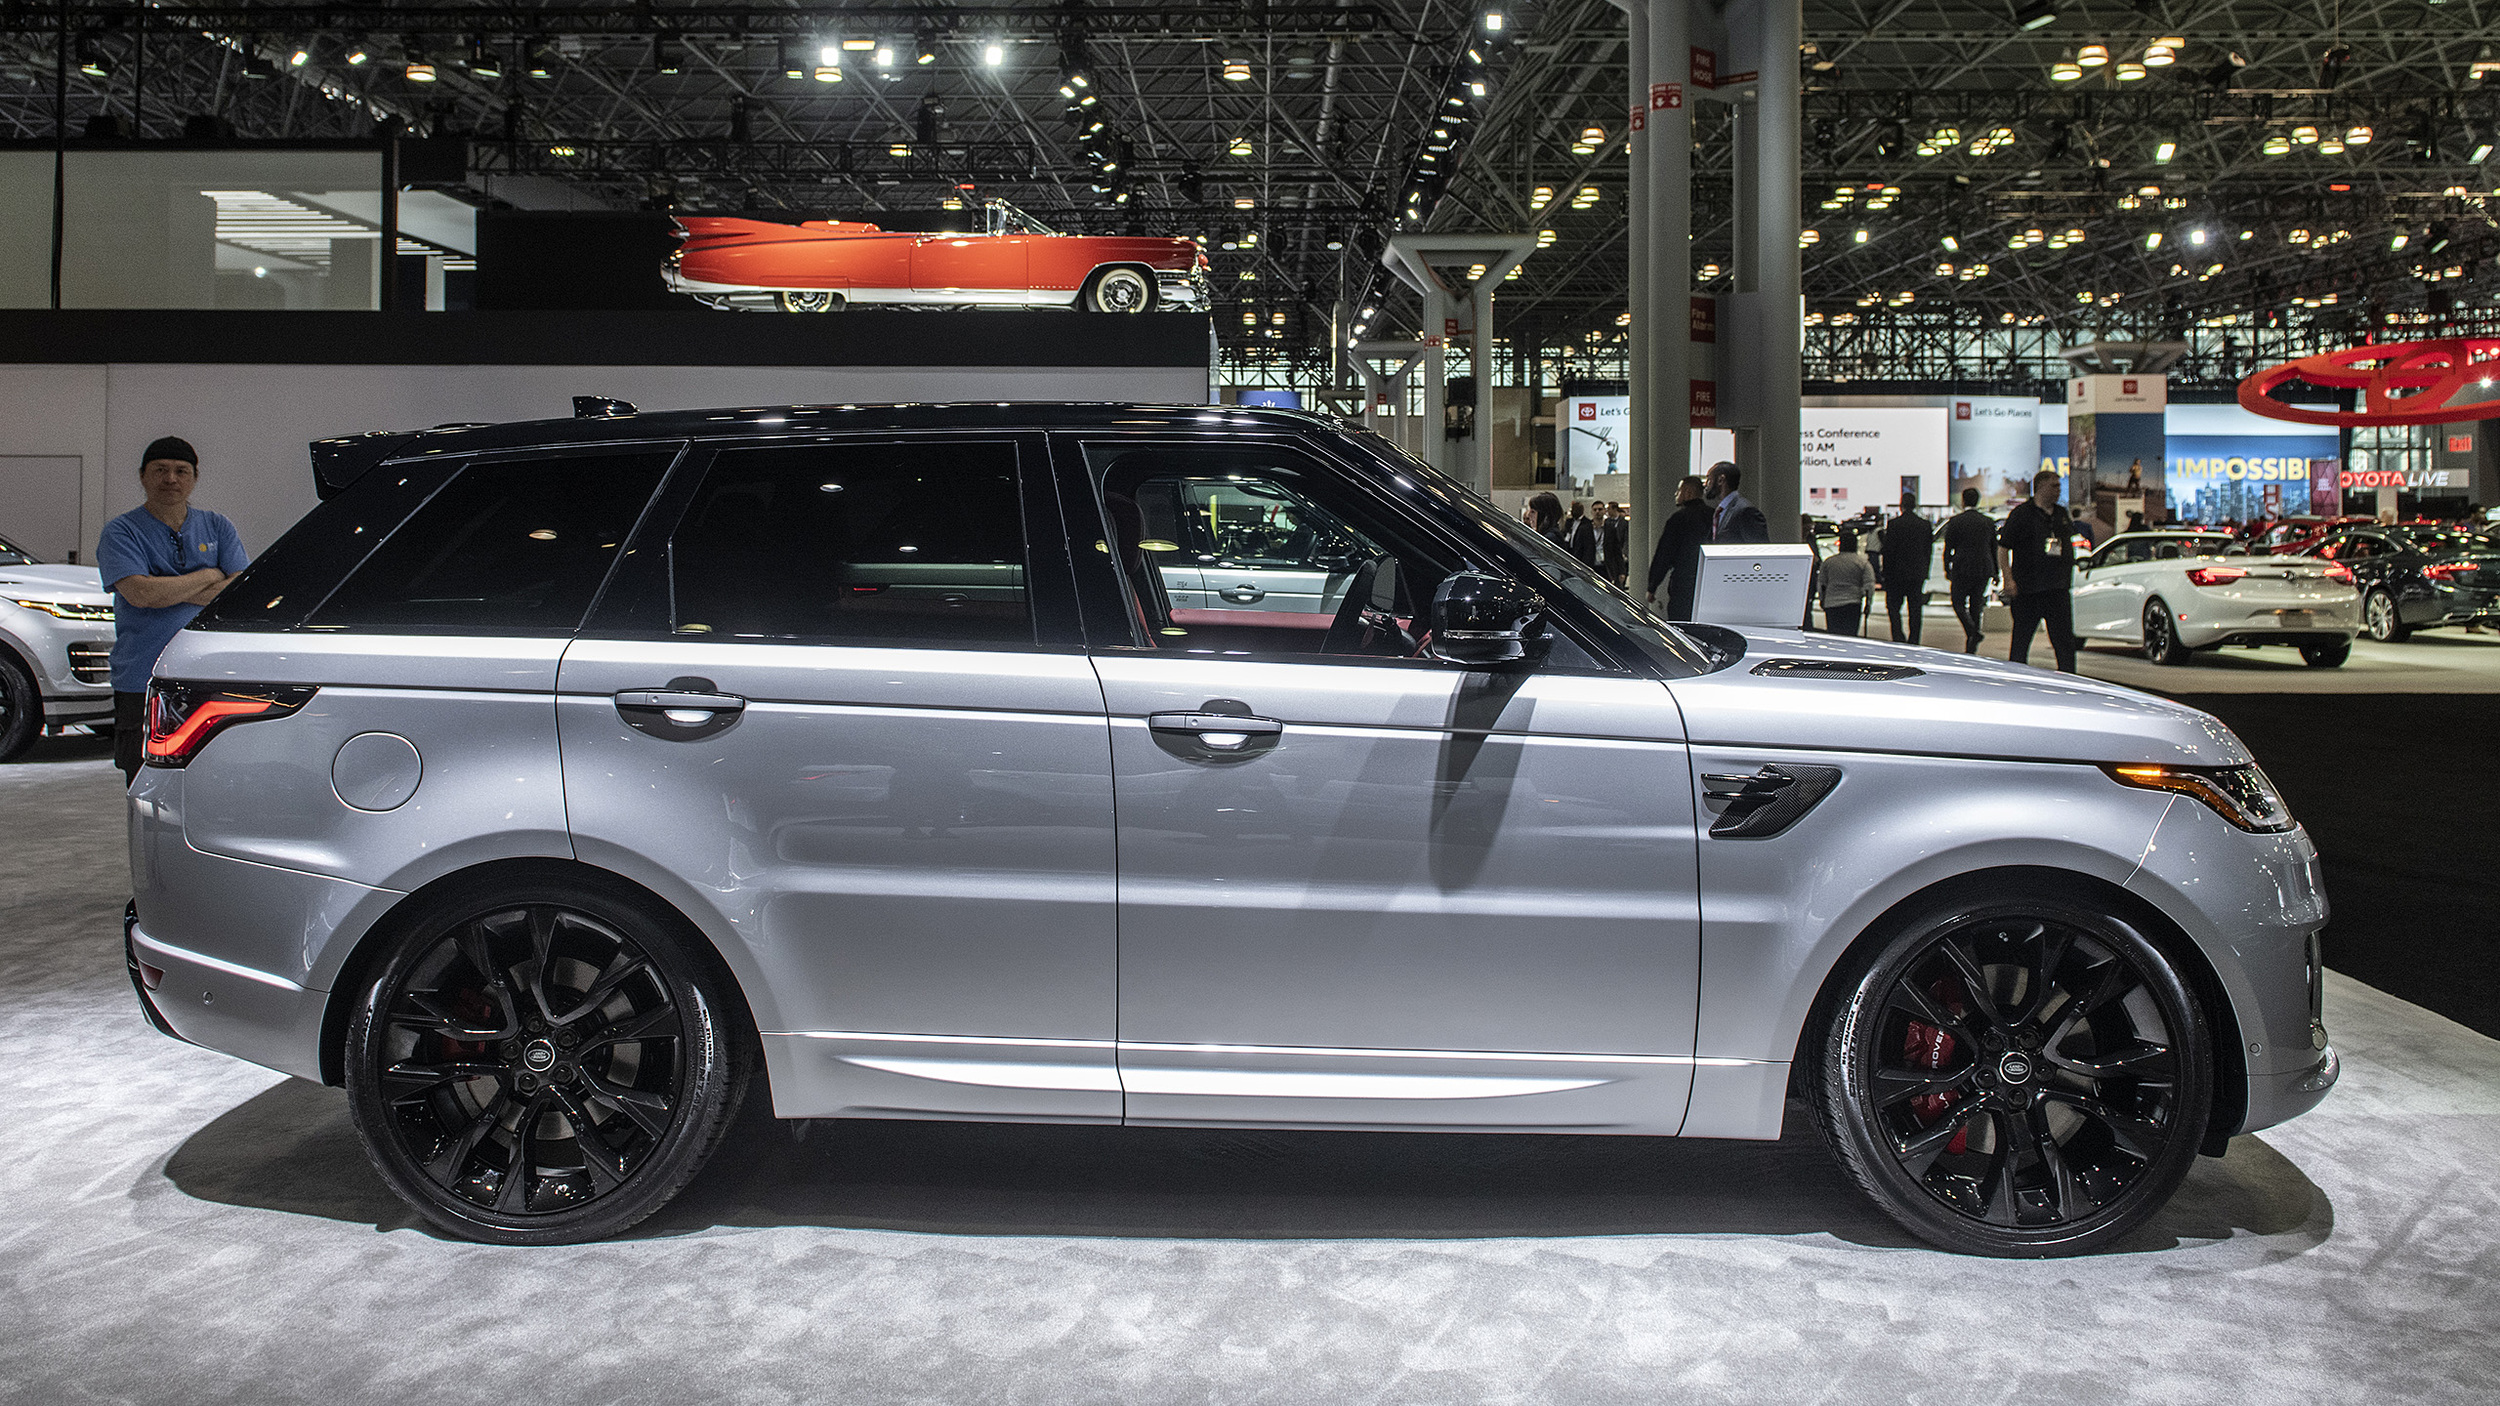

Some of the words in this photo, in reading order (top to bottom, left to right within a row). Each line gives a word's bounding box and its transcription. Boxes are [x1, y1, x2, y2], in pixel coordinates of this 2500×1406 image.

[1691, 308, 1707, 319] Fire
[1691, 320, 1715, 331] Alarm
[1695, 391, 1711, 402] FIRE
[1600, 408, 1621, 416] Let's
[1691, 406, 1716, 417] ALARM
[1817, 428, 1880, 438] Conference
[1816, 443, 1835, 452] AM
[1834, 456, 1862, 467] Level
[1865, 457, 1872, 466] 4
[2407, 471, 2450, 487] LIVE
